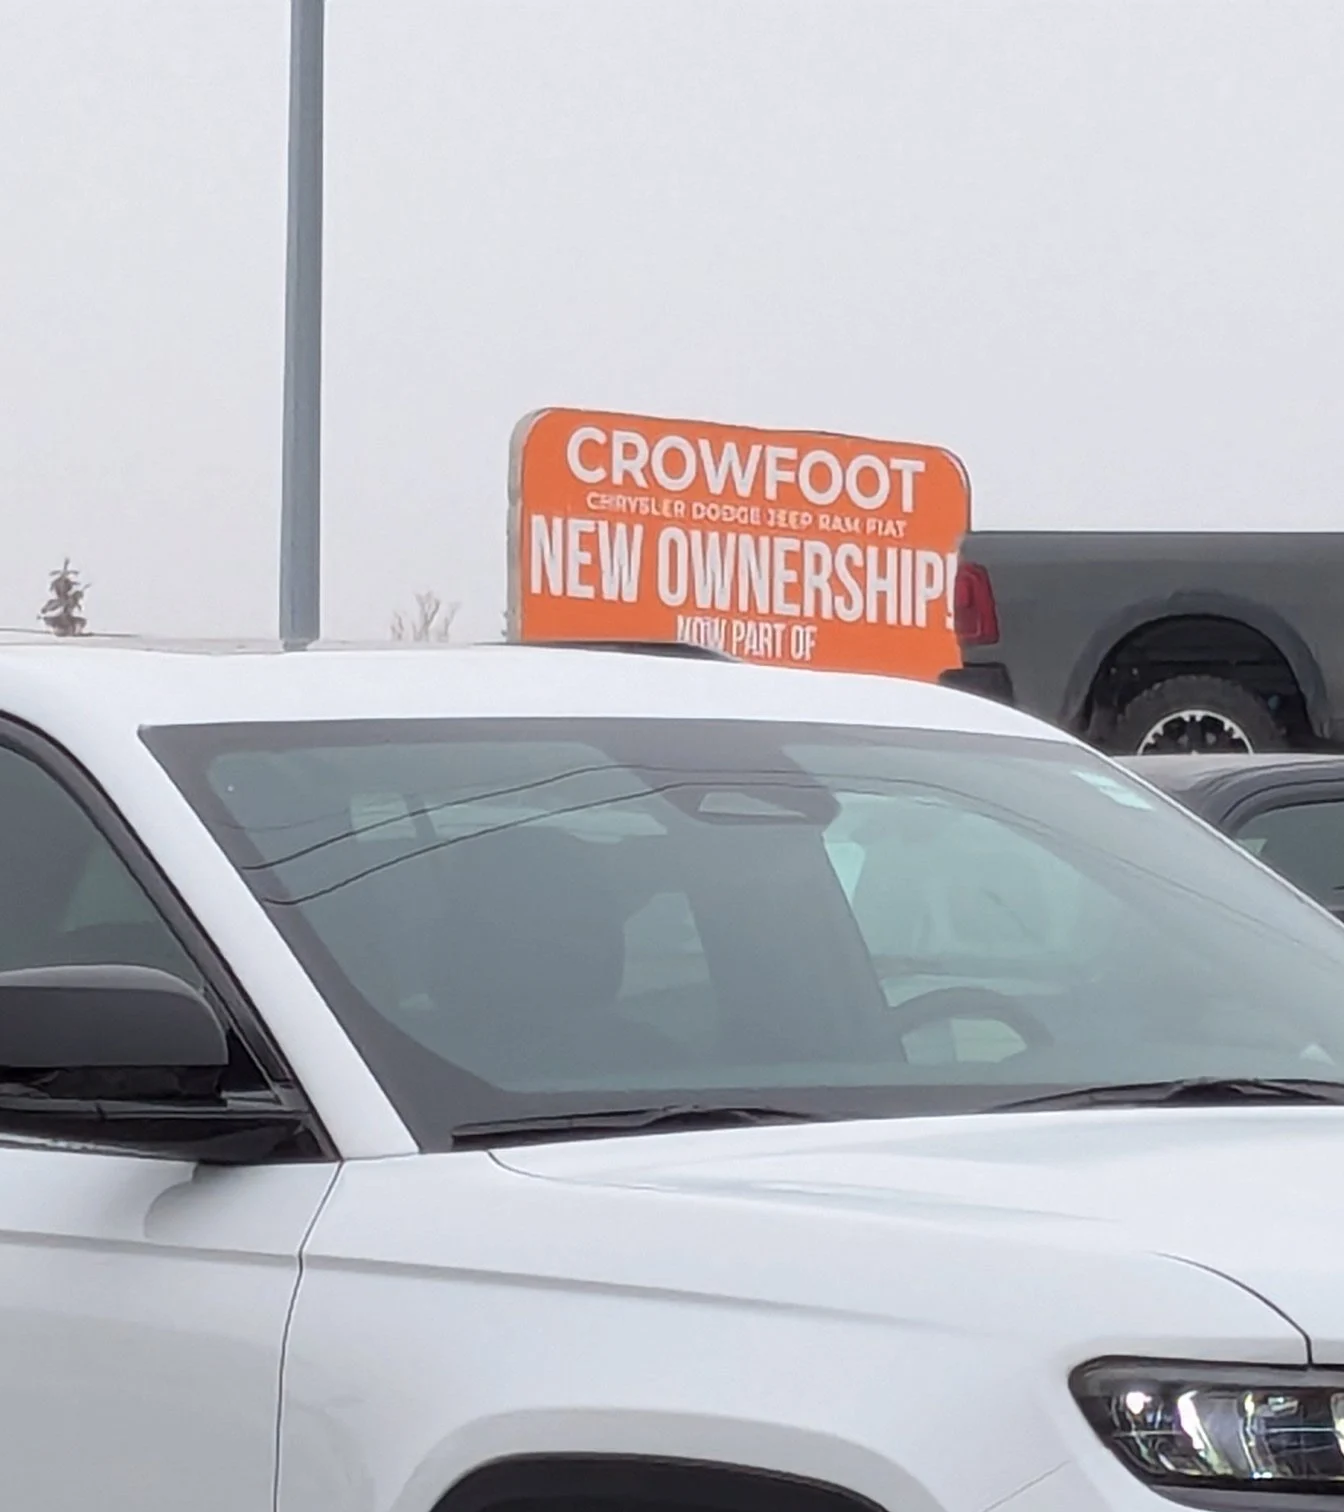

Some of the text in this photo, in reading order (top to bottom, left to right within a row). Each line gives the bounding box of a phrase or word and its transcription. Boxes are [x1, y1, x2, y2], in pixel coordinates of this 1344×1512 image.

[566, 426, 926, 514] CROWFOOT
[586, 491, 908, 538] CHRYSLER DODGE JEEP RAM FIAT
[531, 514, 644, 603] NEW
[677, 614, 818, 661] NOW PART OF
